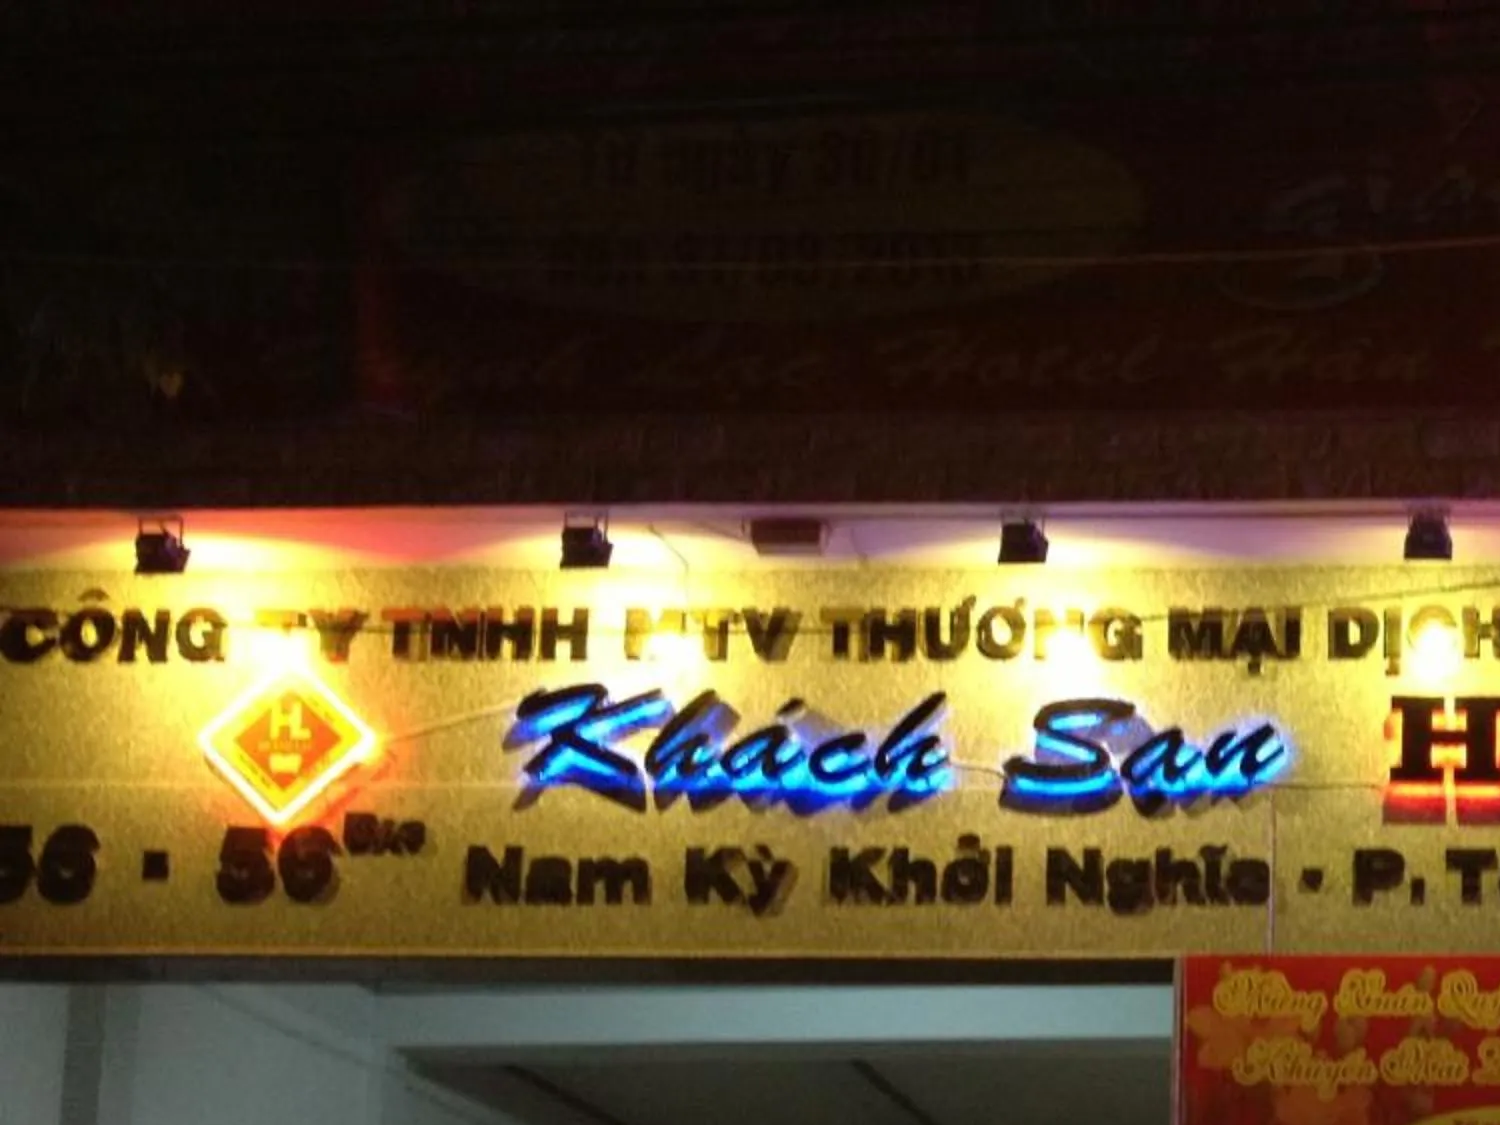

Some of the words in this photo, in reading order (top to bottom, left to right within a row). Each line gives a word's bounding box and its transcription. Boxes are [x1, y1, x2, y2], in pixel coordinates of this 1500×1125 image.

[0, 588, 226, 665] CÔNG
[380, 606, 590, 662] TNHH
[622, 606, 800, 663] MTV
[1167, 606, 1303, 674] MẠI
[505, 684, 950, 812] Khách
[216, 824, 345, 906] 56
[463, 845, 652, 905] Nam
[684, 845, 798, 916] Kỳ
[828, 833, 1014, 906] Khởi
[1045, 843, 1272, 916] Nghĩa
